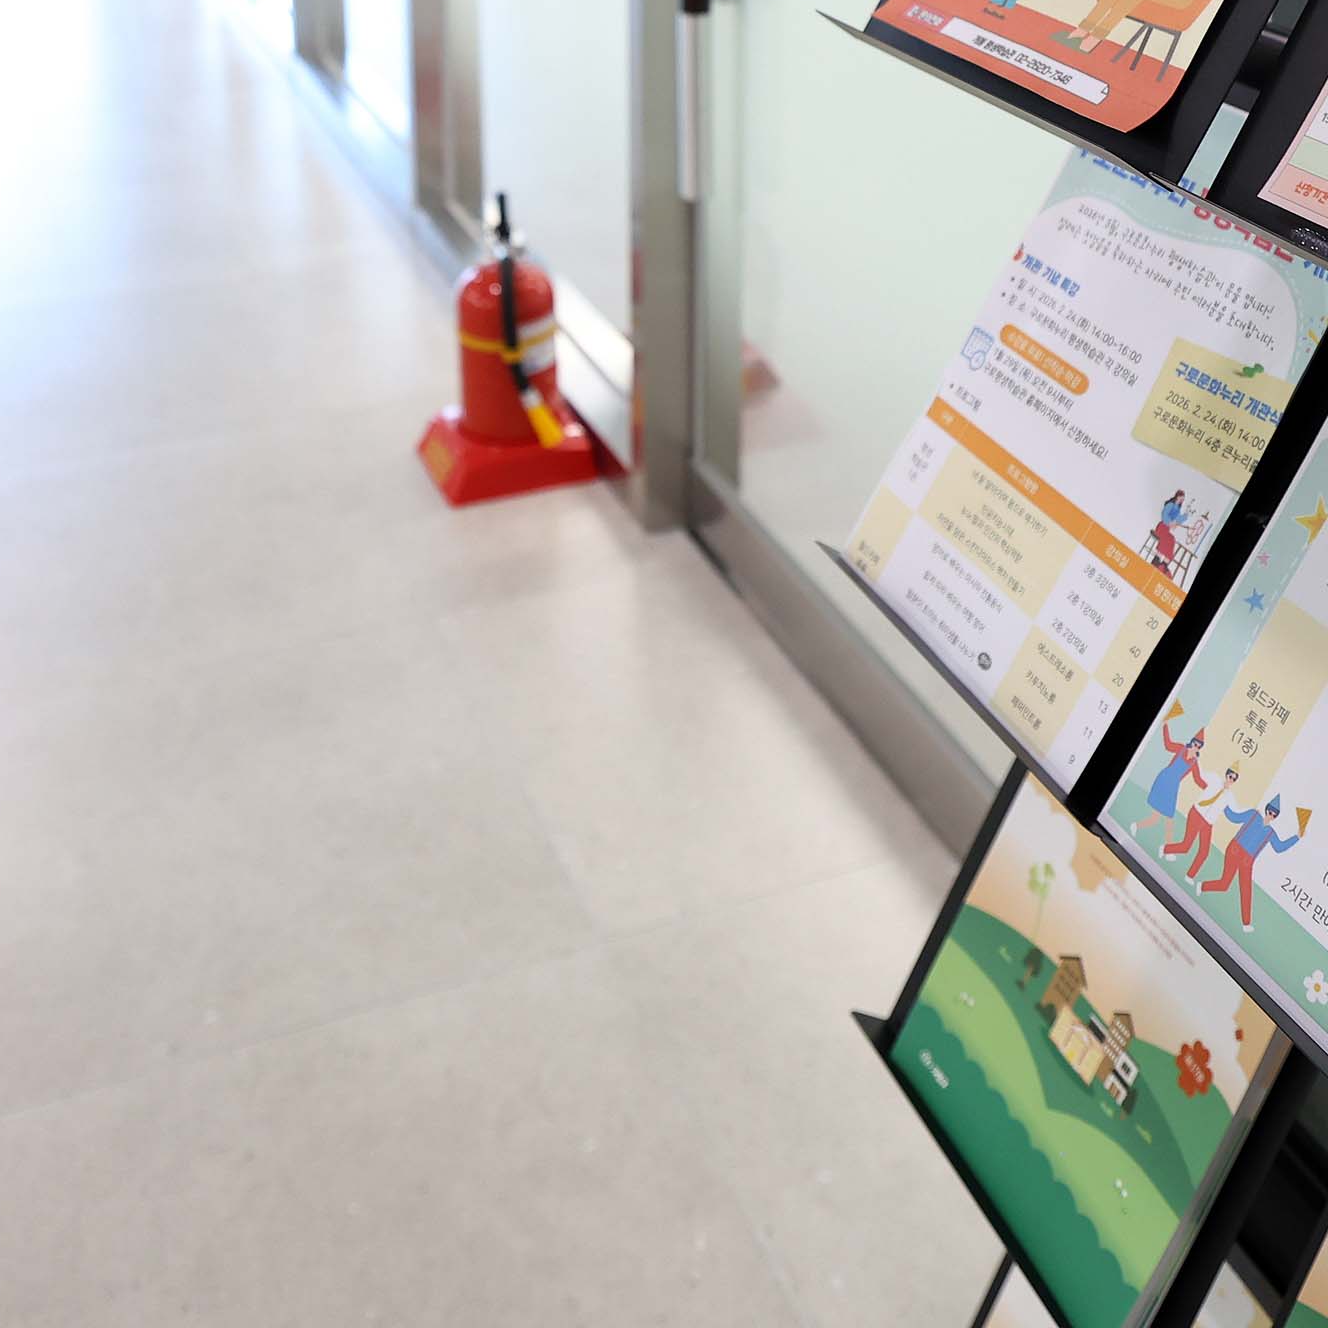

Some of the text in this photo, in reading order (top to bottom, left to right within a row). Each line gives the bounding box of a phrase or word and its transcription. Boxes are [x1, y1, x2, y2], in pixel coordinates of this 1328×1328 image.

[1176, 361, 1245, 408] 구로문화누리
[1153, 406, 1221, 453] 구로문화누리 4층
[1238, 429, 1266, 451] 14:00
[1245, 681, 1292, 726] 월드카페
[1230, 727, 1260, 758] (1층)
[1243, 711, 1269, 738] 톡톡
